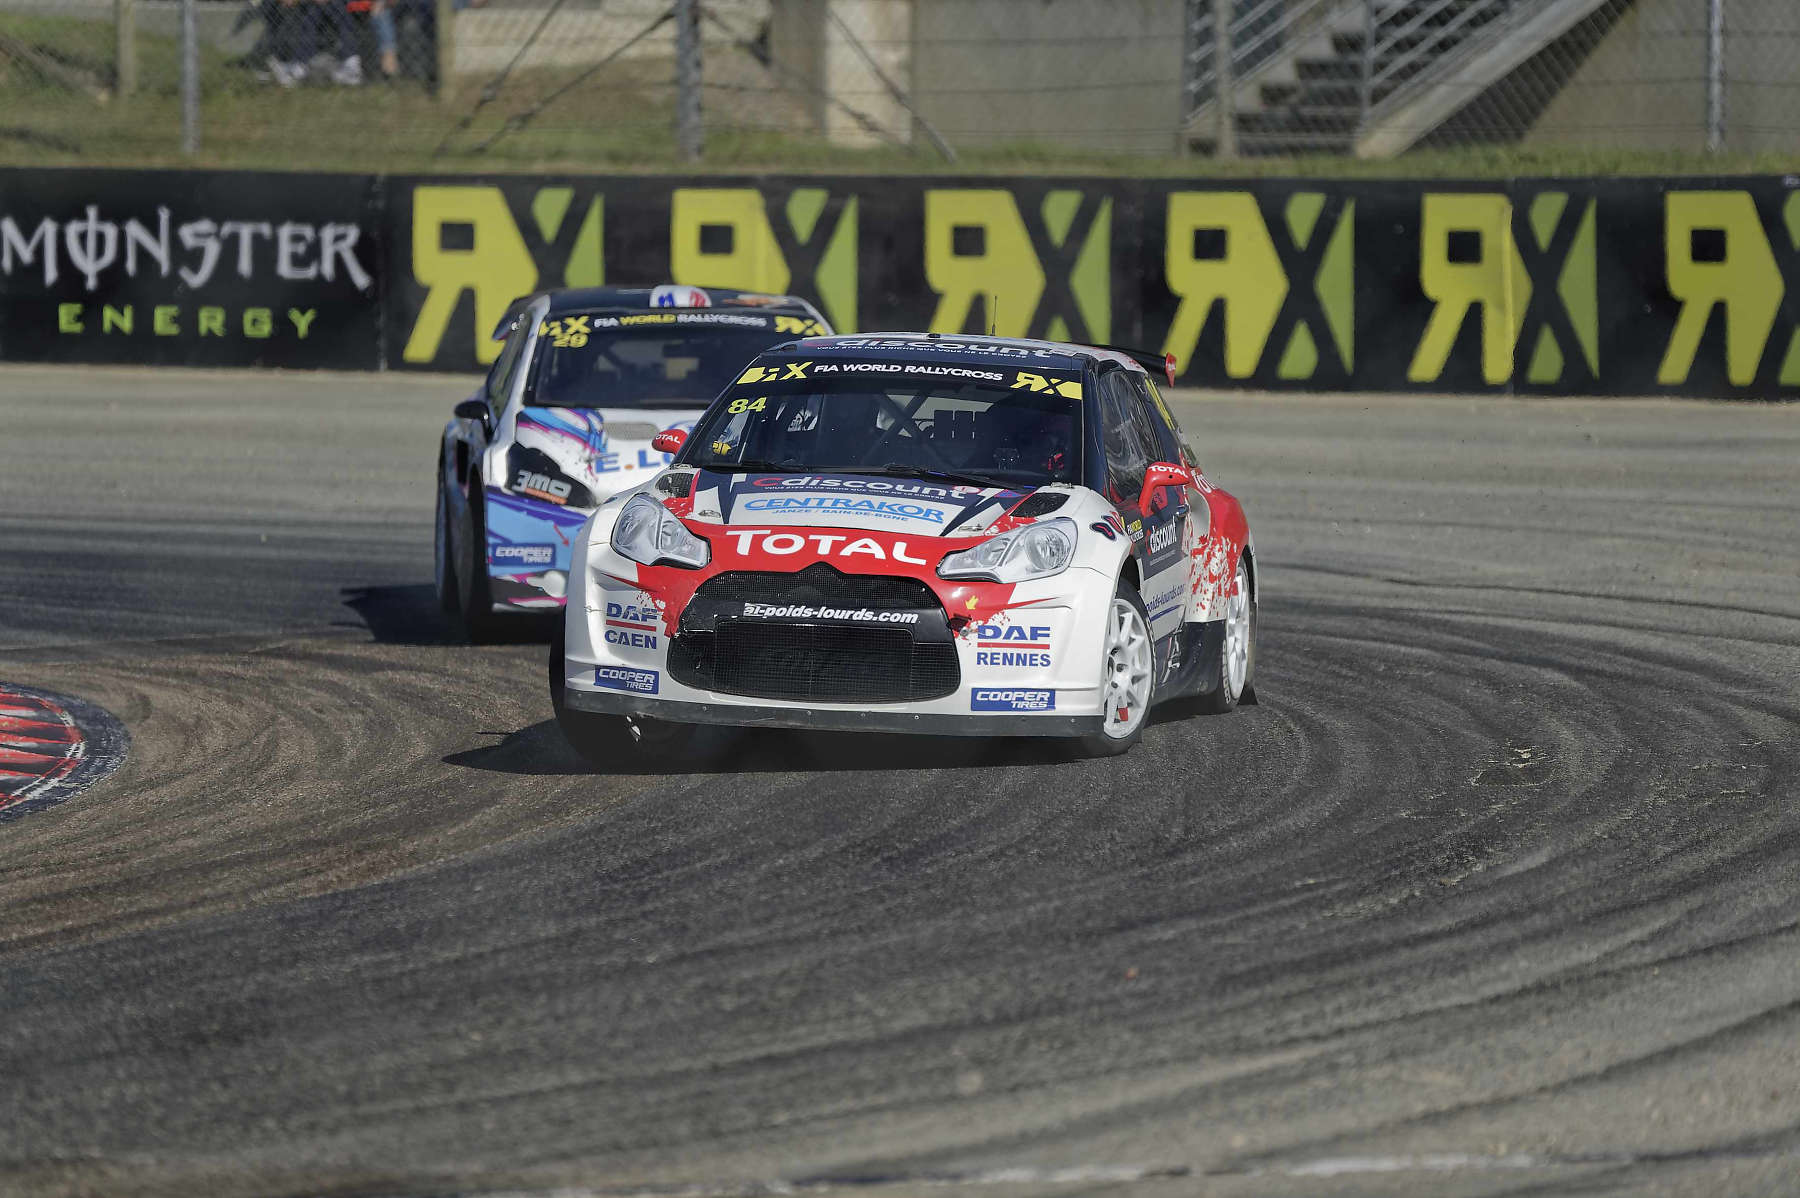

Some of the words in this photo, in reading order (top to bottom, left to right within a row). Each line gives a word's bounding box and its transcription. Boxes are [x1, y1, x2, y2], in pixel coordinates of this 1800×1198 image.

[0, 205, 372, 291] MONSTER
[57, 303, 317, 339] ENERGY
[594, 317, 619, 328] FIA
[620, 314, 677, 326] WORLD
[677, 313, 767, 328] RALLYCROSS
[552, 332, 588, 349] 29
[814, 364, 839, 373] FIA
[842, 363, 902, 373] WORLD
[904, 365, 1004, 382] RALLYCROSS
[728, 396, 767, 414] 84
[655, 433, 681, 444] OTAL
[1148, 464, 1189, 479] TOTAL
[753, 476, 966, 500] Cdiscount
[743, 497, 946, 522] CENTRAKOR
[726, 529, 927, 566] TOTAL
[606, 602, 659, 623] DAF
[604, 629, 657, 650] CAEN
[976, 624, 1051, 641] DAF
[976, 652, 1052, 668] RENNES
[599, 668, 656, 684] COOPER
[625, 680, 654, 692] TIRES
[976, 691, 1051, 702] COOPER
[1010, 700, 1049, 709] TIRES
